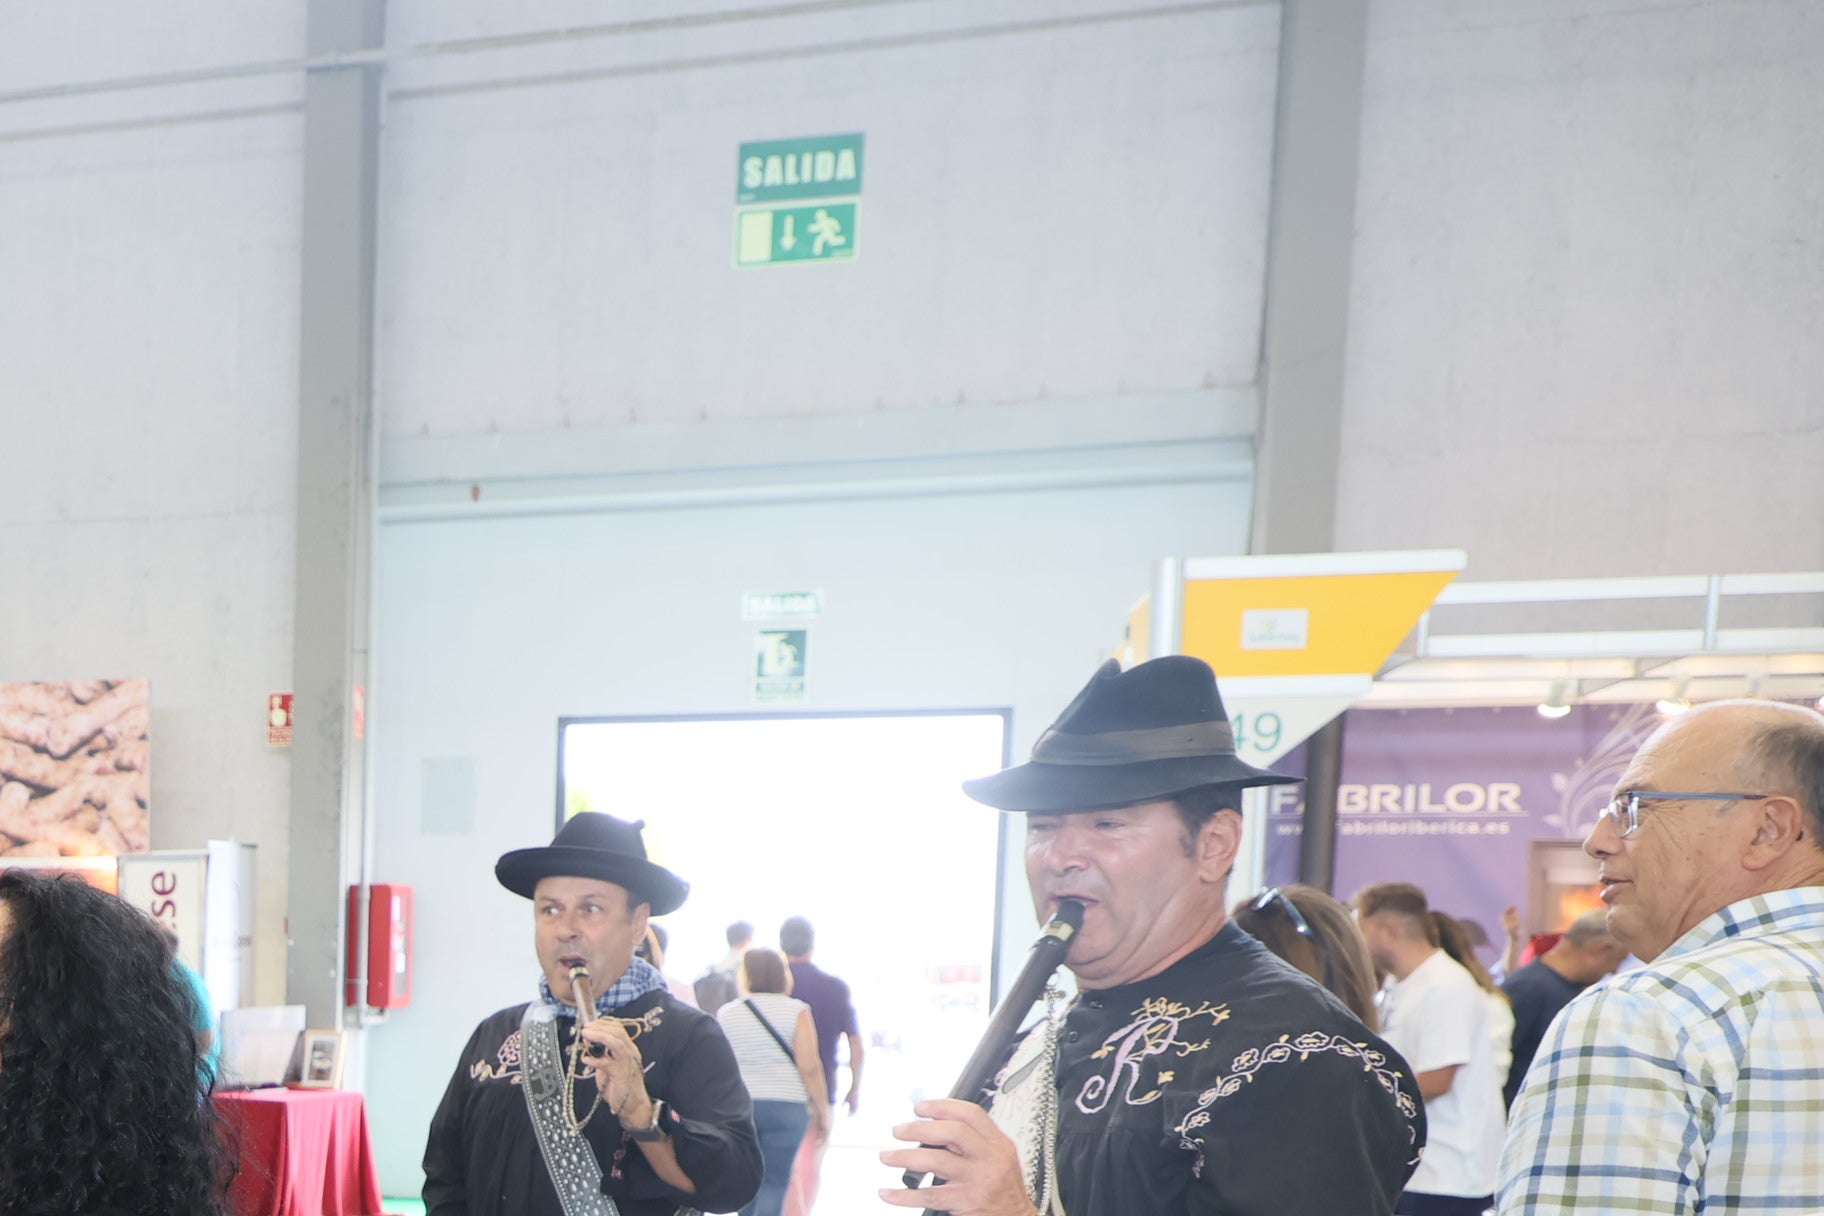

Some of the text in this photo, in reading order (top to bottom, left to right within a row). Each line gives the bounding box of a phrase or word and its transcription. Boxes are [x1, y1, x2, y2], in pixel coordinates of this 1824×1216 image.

[743, 148, 856, 188] SALIDA
[1271, 782, 1523, 815] FBRILOR
[151, 871, 177, 920] se
